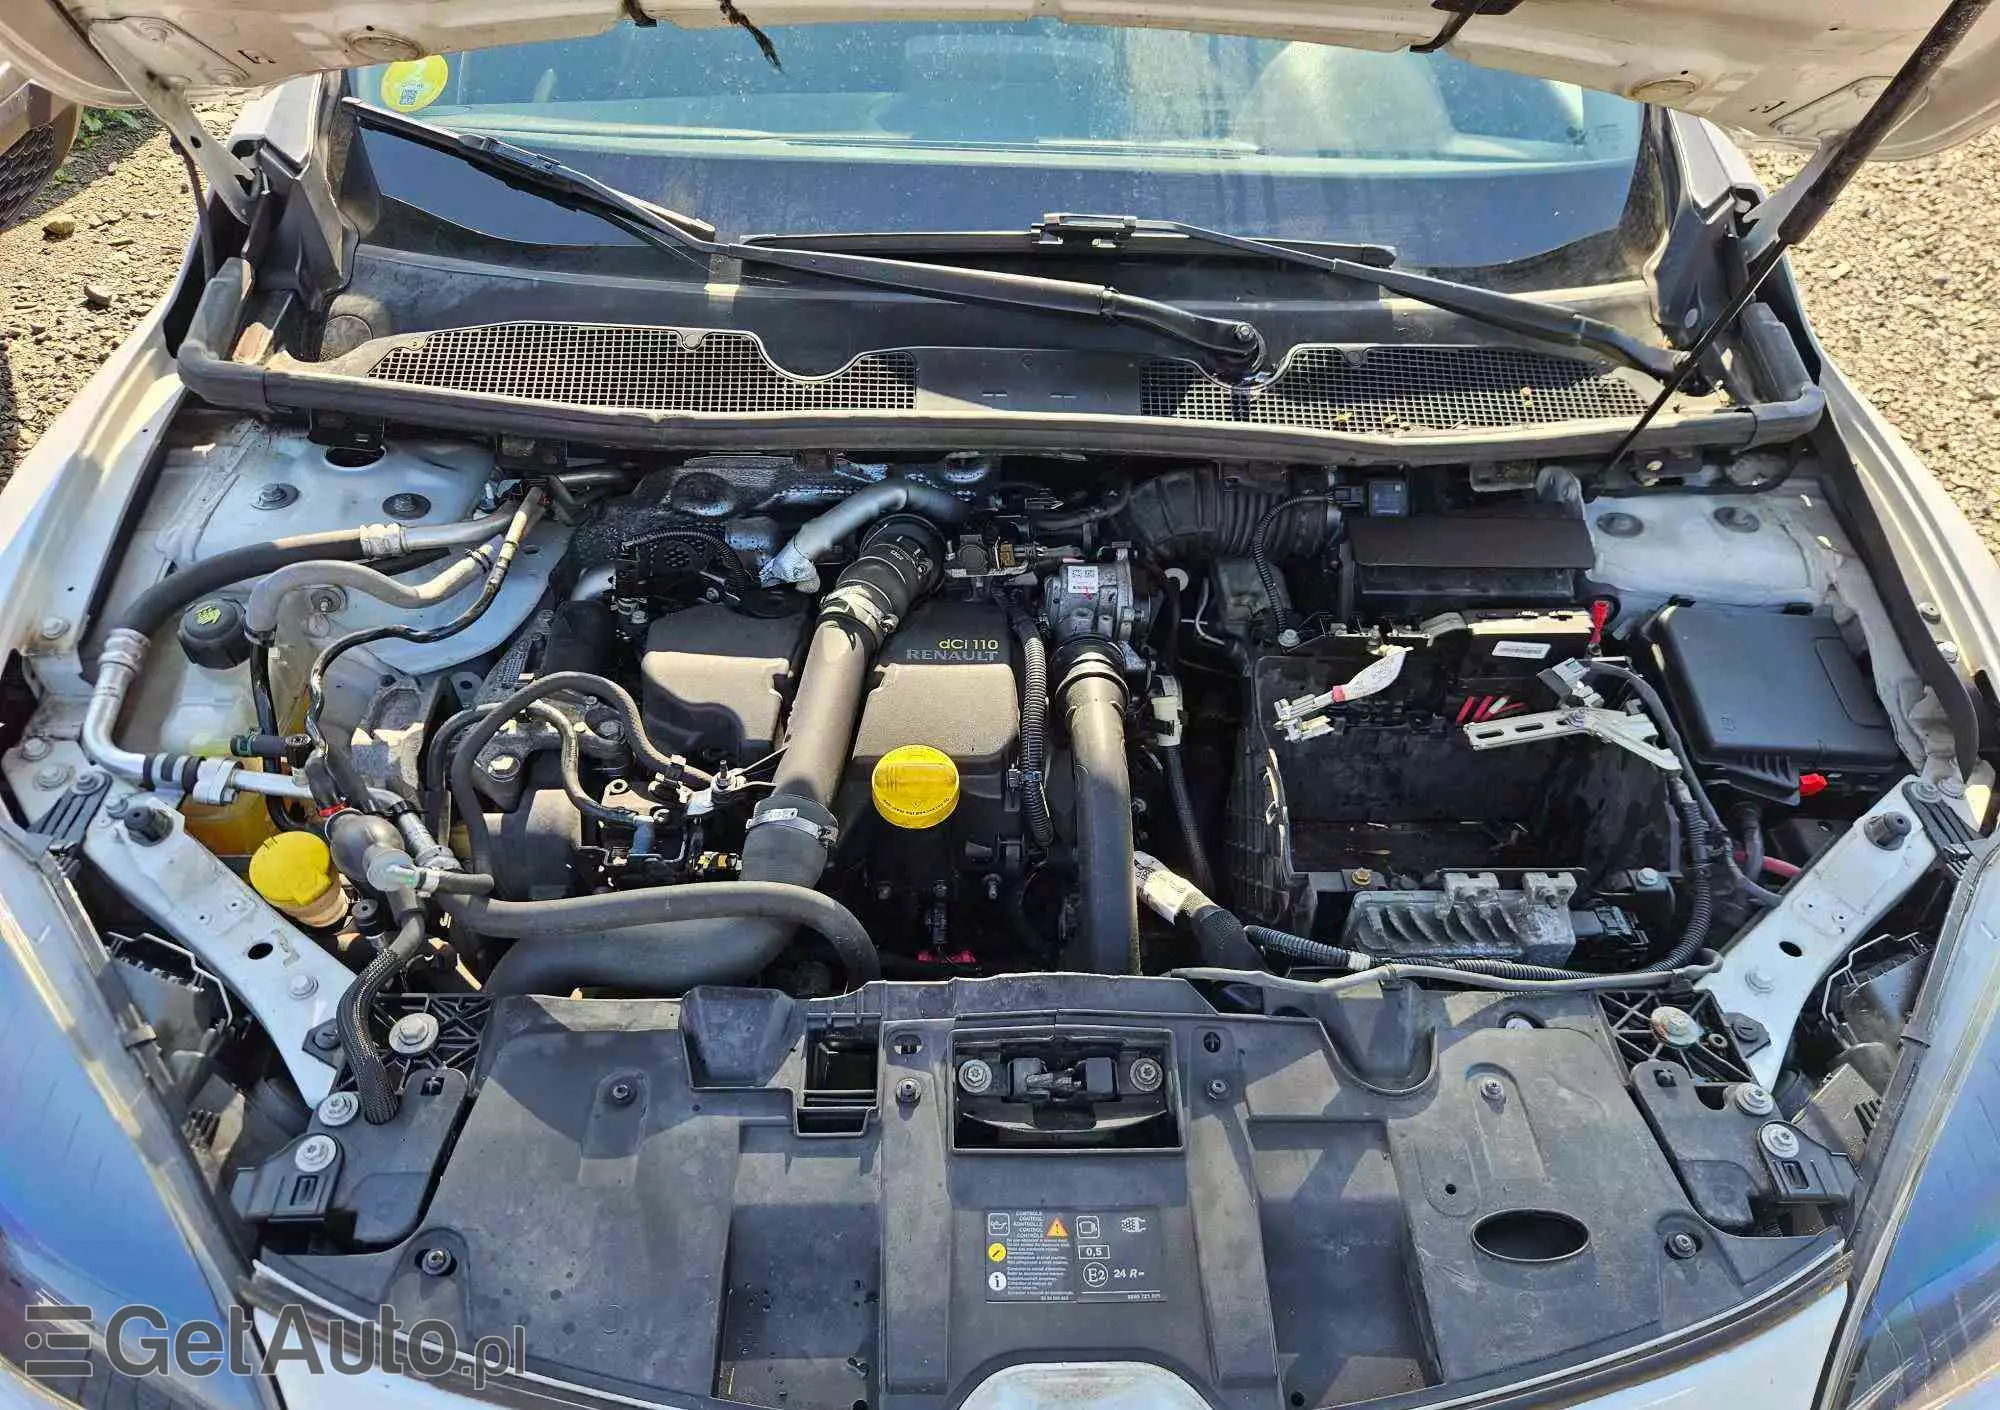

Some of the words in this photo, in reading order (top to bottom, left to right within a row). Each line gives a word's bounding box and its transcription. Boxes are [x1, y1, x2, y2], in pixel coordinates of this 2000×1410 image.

[939, 638, 968, 649] dCi
[972, 639, 999, 650] 110
[906, 648, 998, 661] RENAULT
[1086, 1247, 1103, 1257] 0,5
[1086, 1268, 1106, 1282] E2
[1113, 1268, 1127, 1278] 24
